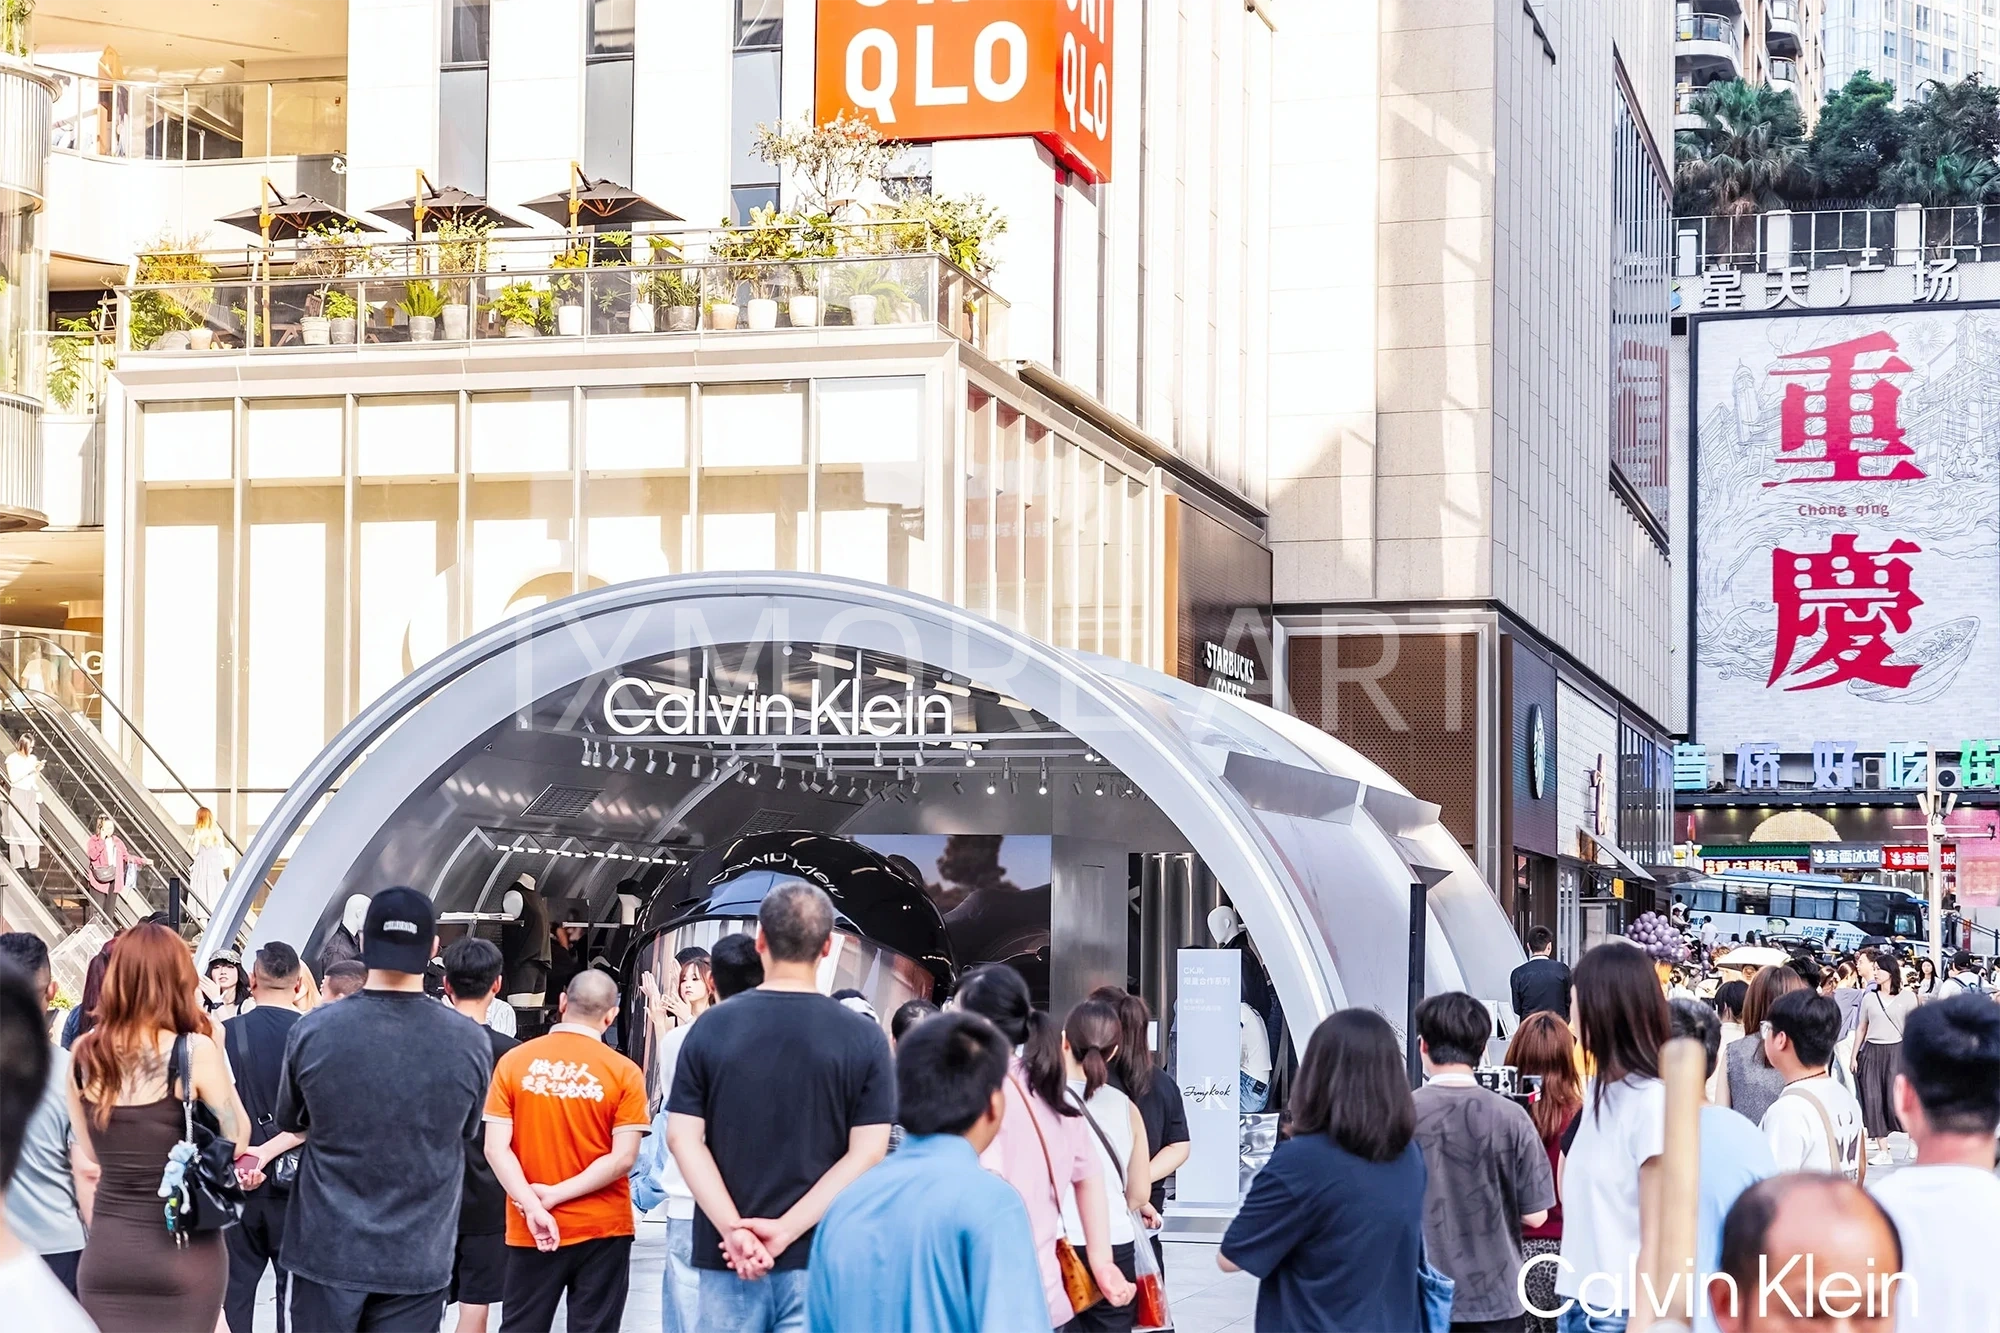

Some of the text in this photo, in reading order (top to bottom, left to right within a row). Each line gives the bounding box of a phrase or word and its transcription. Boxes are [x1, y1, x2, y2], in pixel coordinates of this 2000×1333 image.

[845, 20, 1028, 124] QLO
[1062, 31, 1108, 142] QLO
[1699, 254, 1960, 311] 星天广场
[1762, 330, 1927, 488] 重
[1206, 640, 1254, 686] STARBUCKS
[603, 676, 954, 736] Calvin Klein
[1825, 849, 1880, 864] 蜜雪冰城
[1901, 851, 1956, 865] 蜜雪城
